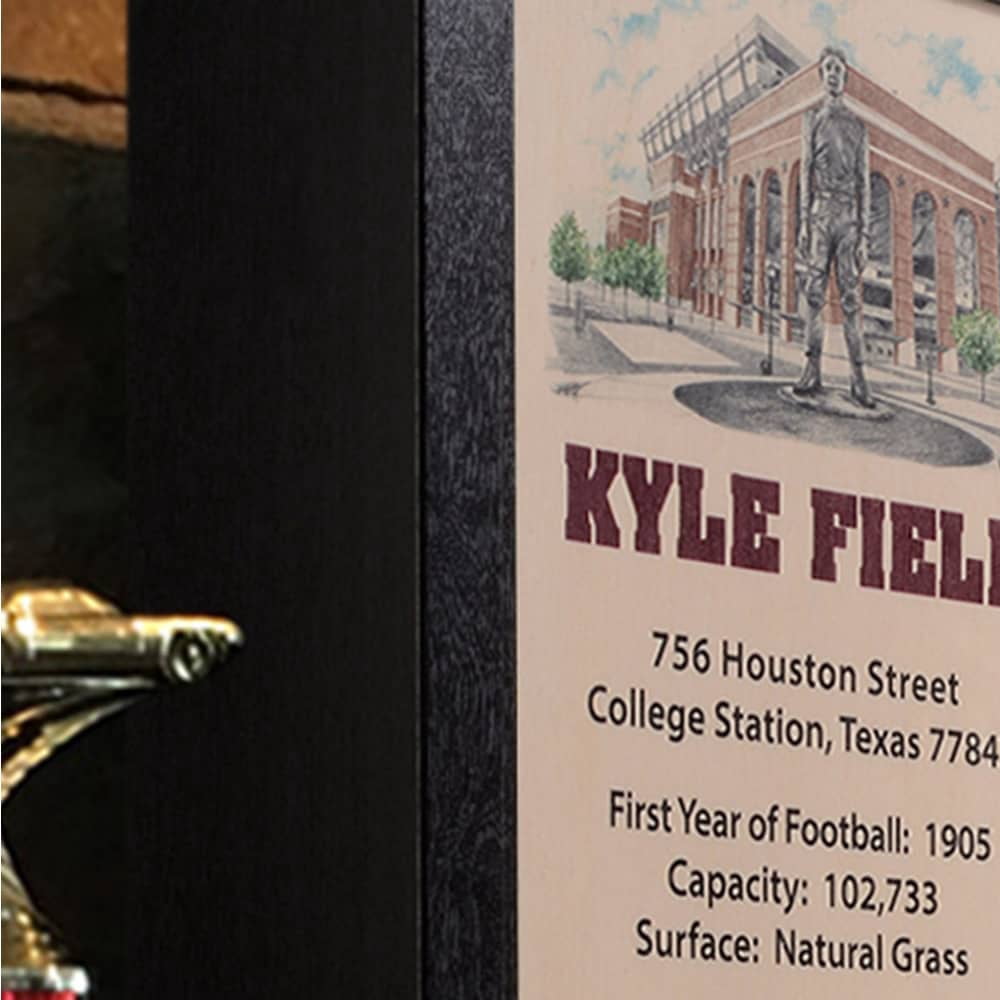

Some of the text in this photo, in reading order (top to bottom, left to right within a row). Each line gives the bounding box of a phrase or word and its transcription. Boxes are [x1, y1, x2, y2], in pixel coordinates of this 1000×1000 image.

[564, 443, 781, 575] KYLE
[651, 630, 960, 707] 756 Houston Street
[588, 685, 706, 744] College
[714, 700, 833, 756] Station,
[838, 715, 921, 761] Texas
[609, 789, 992, 862] First Year of Football: 1905
[667, 858, 939, 918] Capacity: 102,733
[635, 917, 969, 977] Surface: Natural Grass
